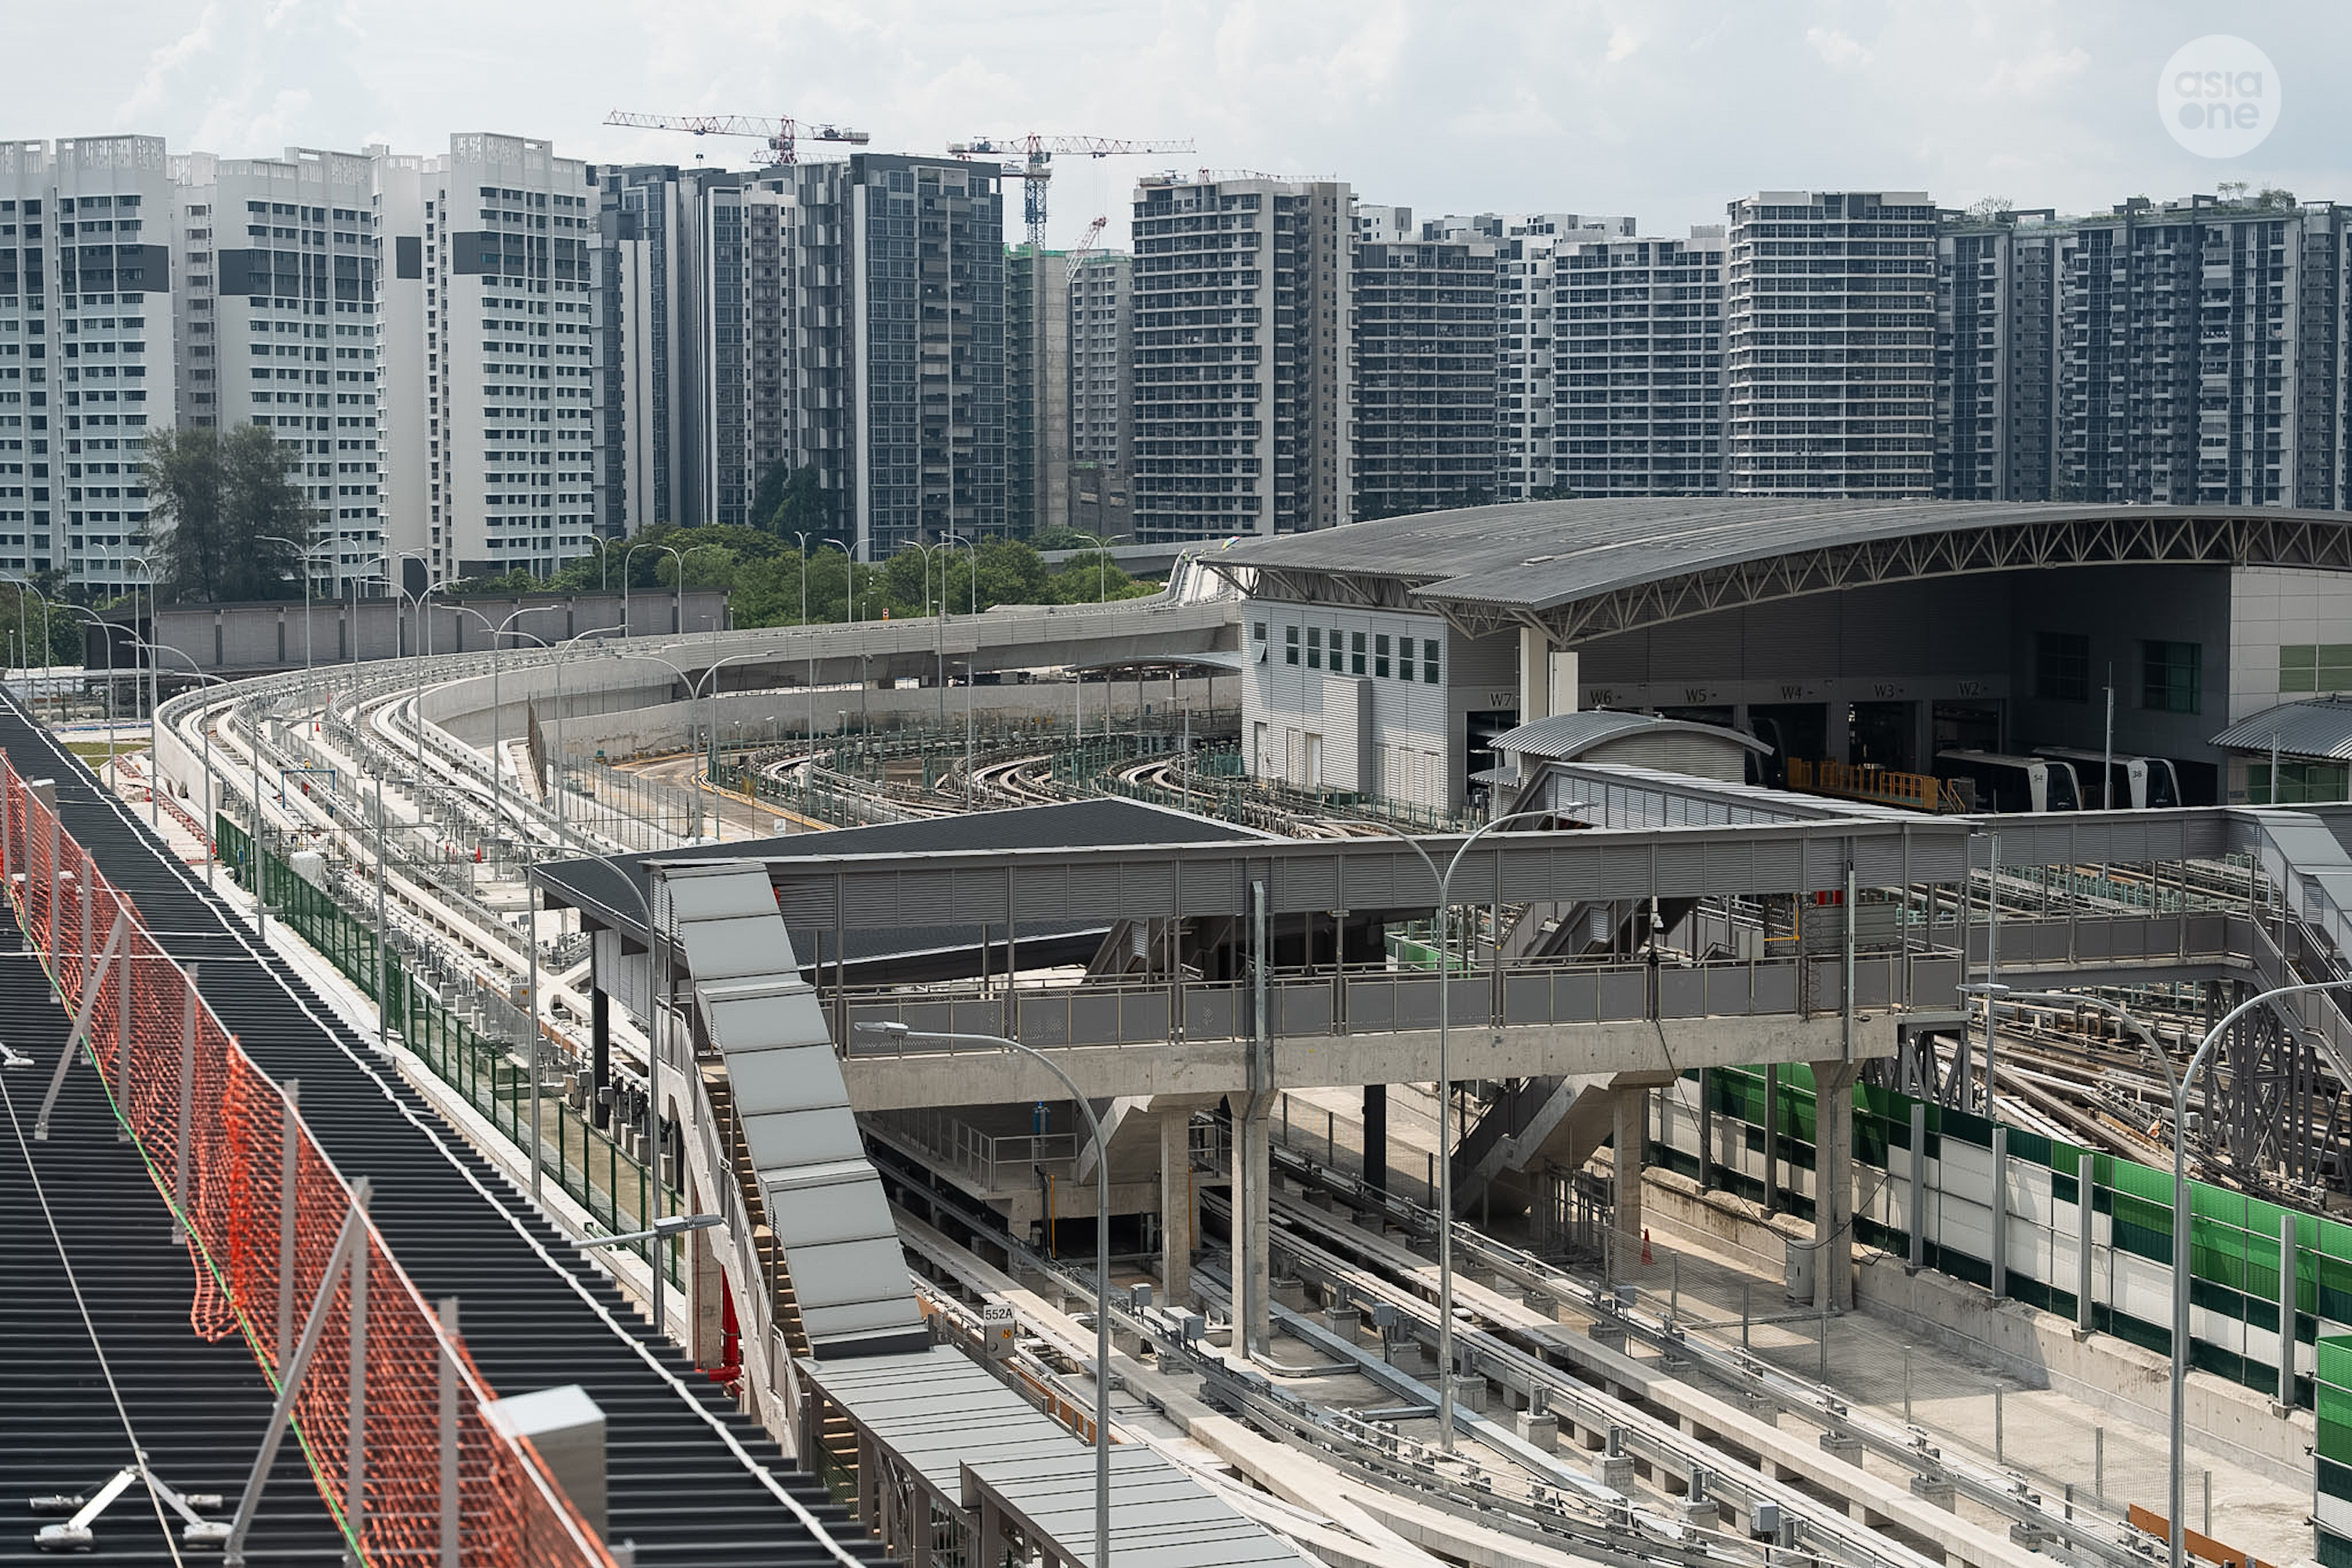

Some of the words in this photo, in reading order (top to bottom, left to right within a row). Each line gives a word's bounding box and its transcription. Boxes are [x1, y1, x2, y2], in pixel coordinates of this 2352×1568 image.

[1686, 688, 1707, 702] W5
[1782, 686, 1802, 699] W4
[1875, 684, 1894, 698] W3
[1958, 681, 1980, 696] W2
[1490, 692, 1513, 706] W7
[1590, 689, 1612, 704] W6
[985, 1308, 1013, 1320] 552A
